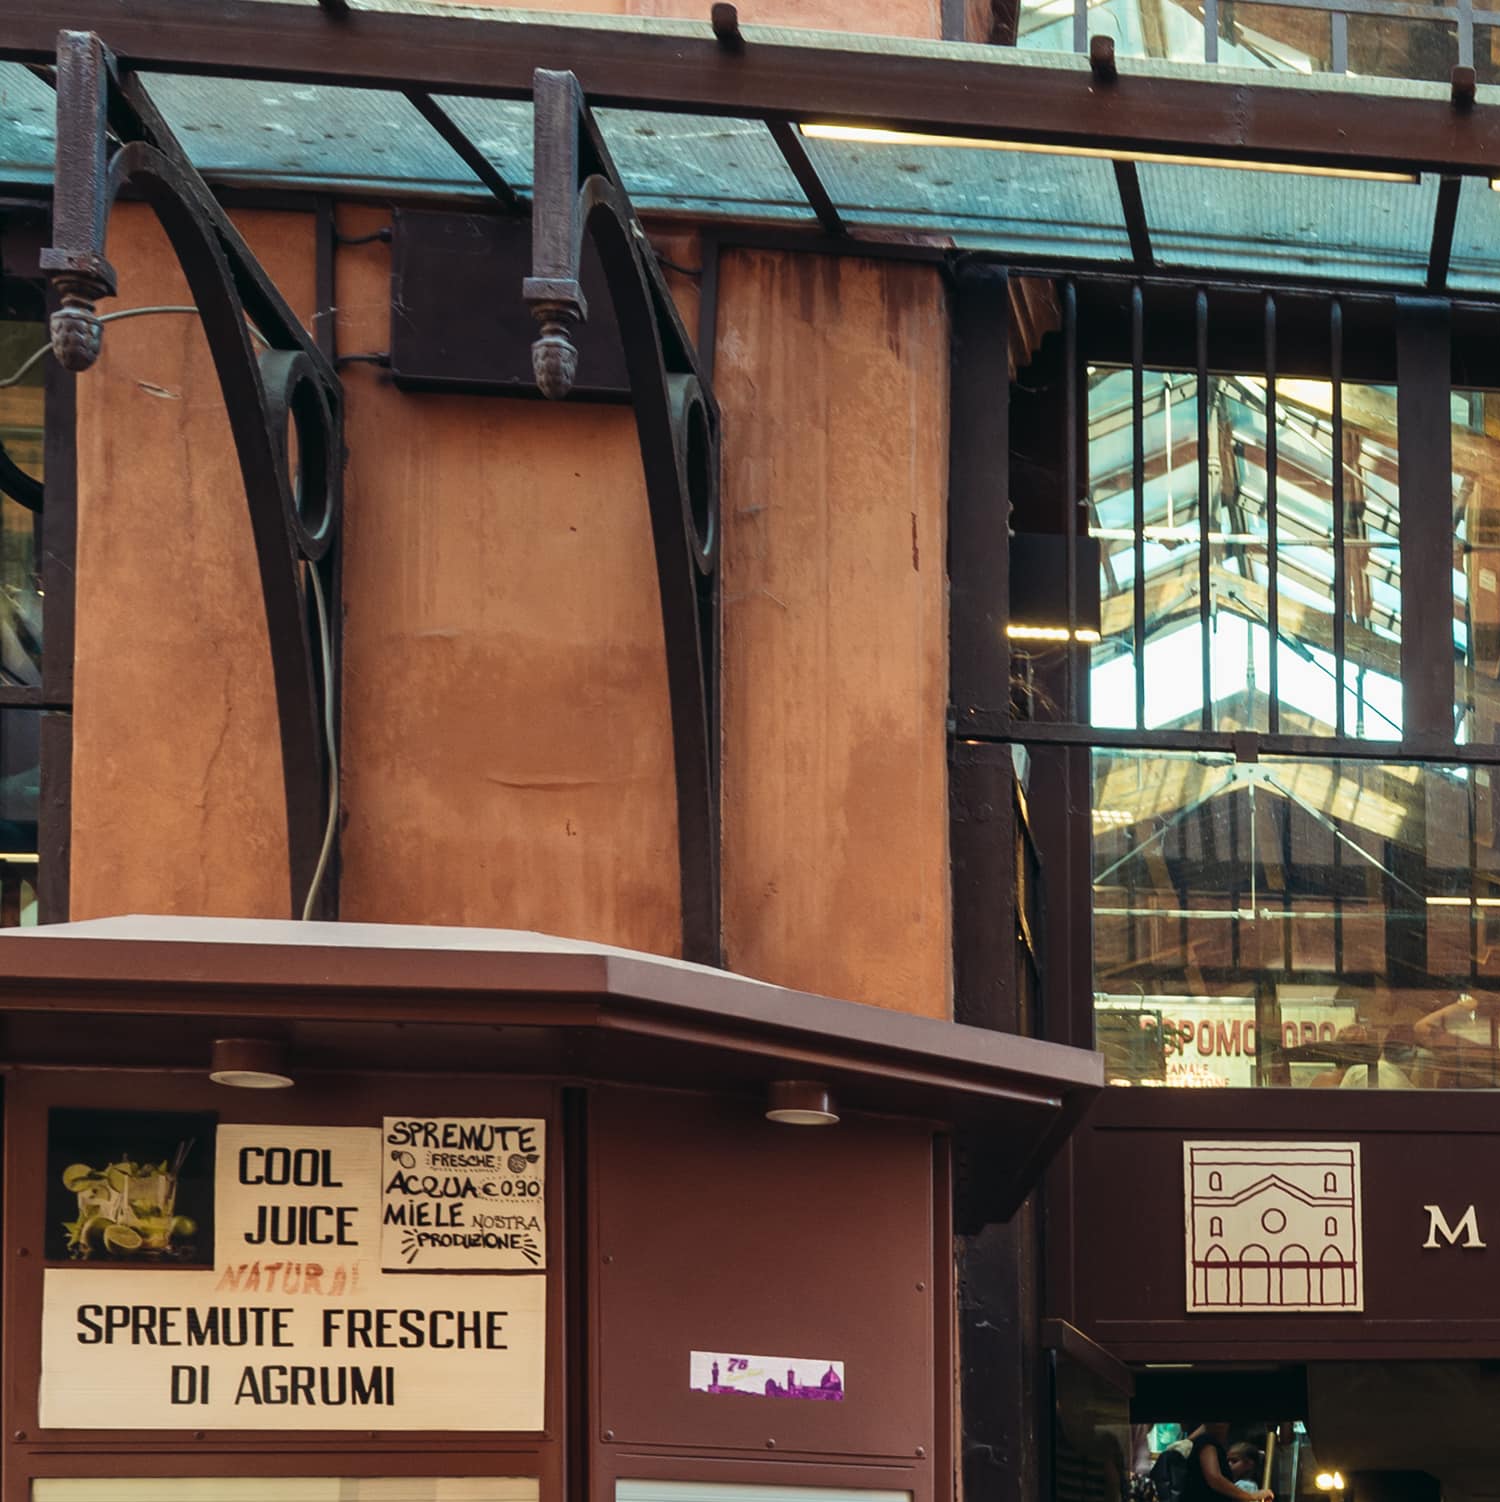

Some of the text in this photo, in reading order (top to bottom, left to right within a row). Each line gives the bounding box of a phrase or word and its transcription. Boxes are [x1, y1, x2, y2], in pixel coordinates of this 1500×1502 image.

[387, 1121, 536, 1152] SPREMUTE
[238, 1147, 342, 1187] COOL
[431, 1153, 495, 1168] FRESCHE
[385, 1170, 478, 1198] ACQUA
[244, 1205, 358, 1246] JUICE
[471, 1214, 541, 1232] NOSTRA
[417, 1229, 522, 1249] PRODUZIONE
[76, 1305, 509, 1350] SPREMUTE FRESCHE
[171, 1366, 395, 1406] DI AGRUMI
